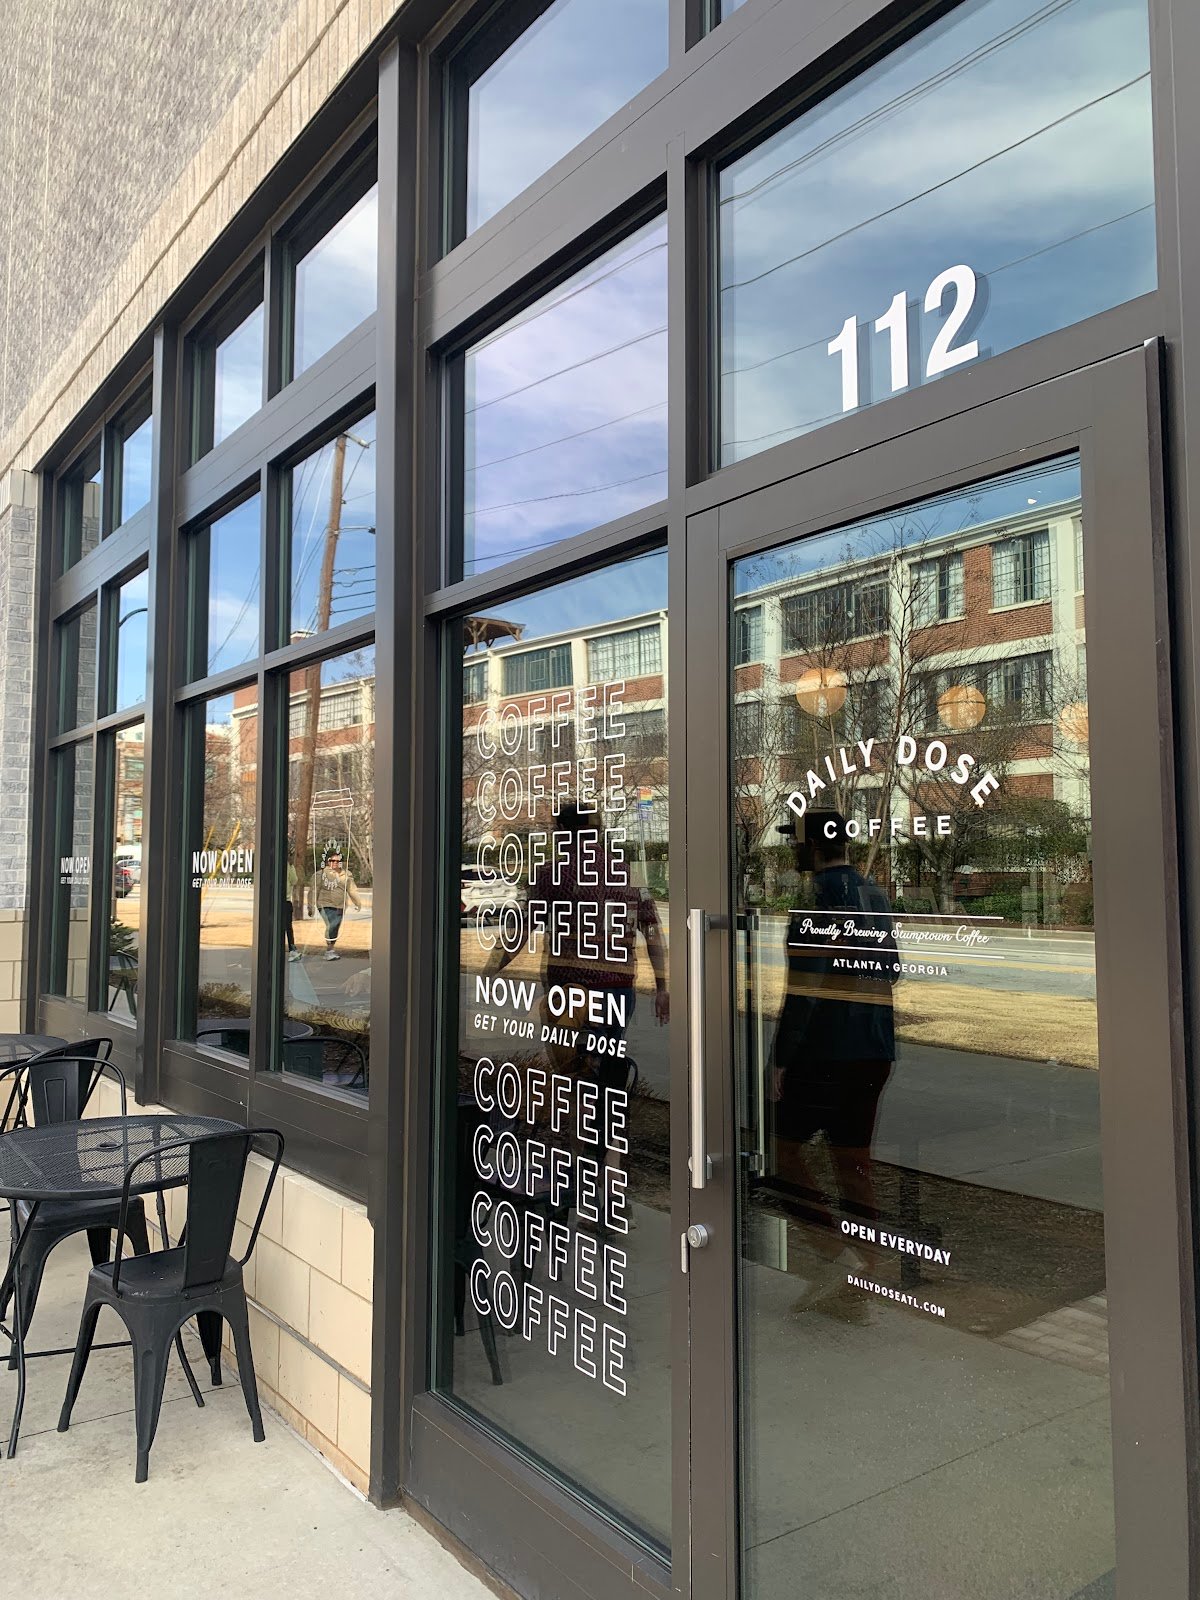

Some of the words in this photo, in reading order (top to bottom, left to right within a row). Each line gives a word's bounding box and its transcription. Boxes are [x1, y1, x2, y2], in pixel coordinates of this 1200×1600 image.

[828, 264, 979, 412] 112
[476, 680, 626, 759] COFFEE
[476, 753, 626, 822] COFFEE
[786, 737, 875, 817] DAILY
[897, 735, 1000, 808] DOSE
[823, 815, 952, 839] COFFEE
[60, 856, 74, 874] NOW
[192, 850, 218, 874] NOW
[221, 849, 253, 873] OPEN
[192, 877, 203, 888] GET
[476, 828, 627, 886] COFFEE
[476, 899, 627, 963] COFFEE
[799, 918, 842, 941] Proudly
[843, 920, 888, 943] Brewing
[890, 922, 953, 944] Stumptown
[955, 925, 990, 946] Coffee
[832, 958, 882, 971] ATLANTA
[892, 962, 948, 976] GEORGIA
[475, 975, 536, 1011] NOW
[548, 984, 626, 1028] OPEN
[474, 1013, 497, 1032] GET
[503, 1018, 535, 1039] YOUR
[541, 1025, 579, 1048] DAILY
[586, 1033, 627, 1059] DOSE
[473, 1057, 628, 1154] COFFEE
[472, 1124, 628, 1234] COFFEE
[471, 1191, 627, 1315] COFFEE
[841, 1220, 876, 1243] OPEN
[880, 1231, 951, 1266] EVERYDAY
[847, 1274, 946, 1317] DAILYDOSEATL.COM
[470, 1258, 627, 1396] COFFEE
